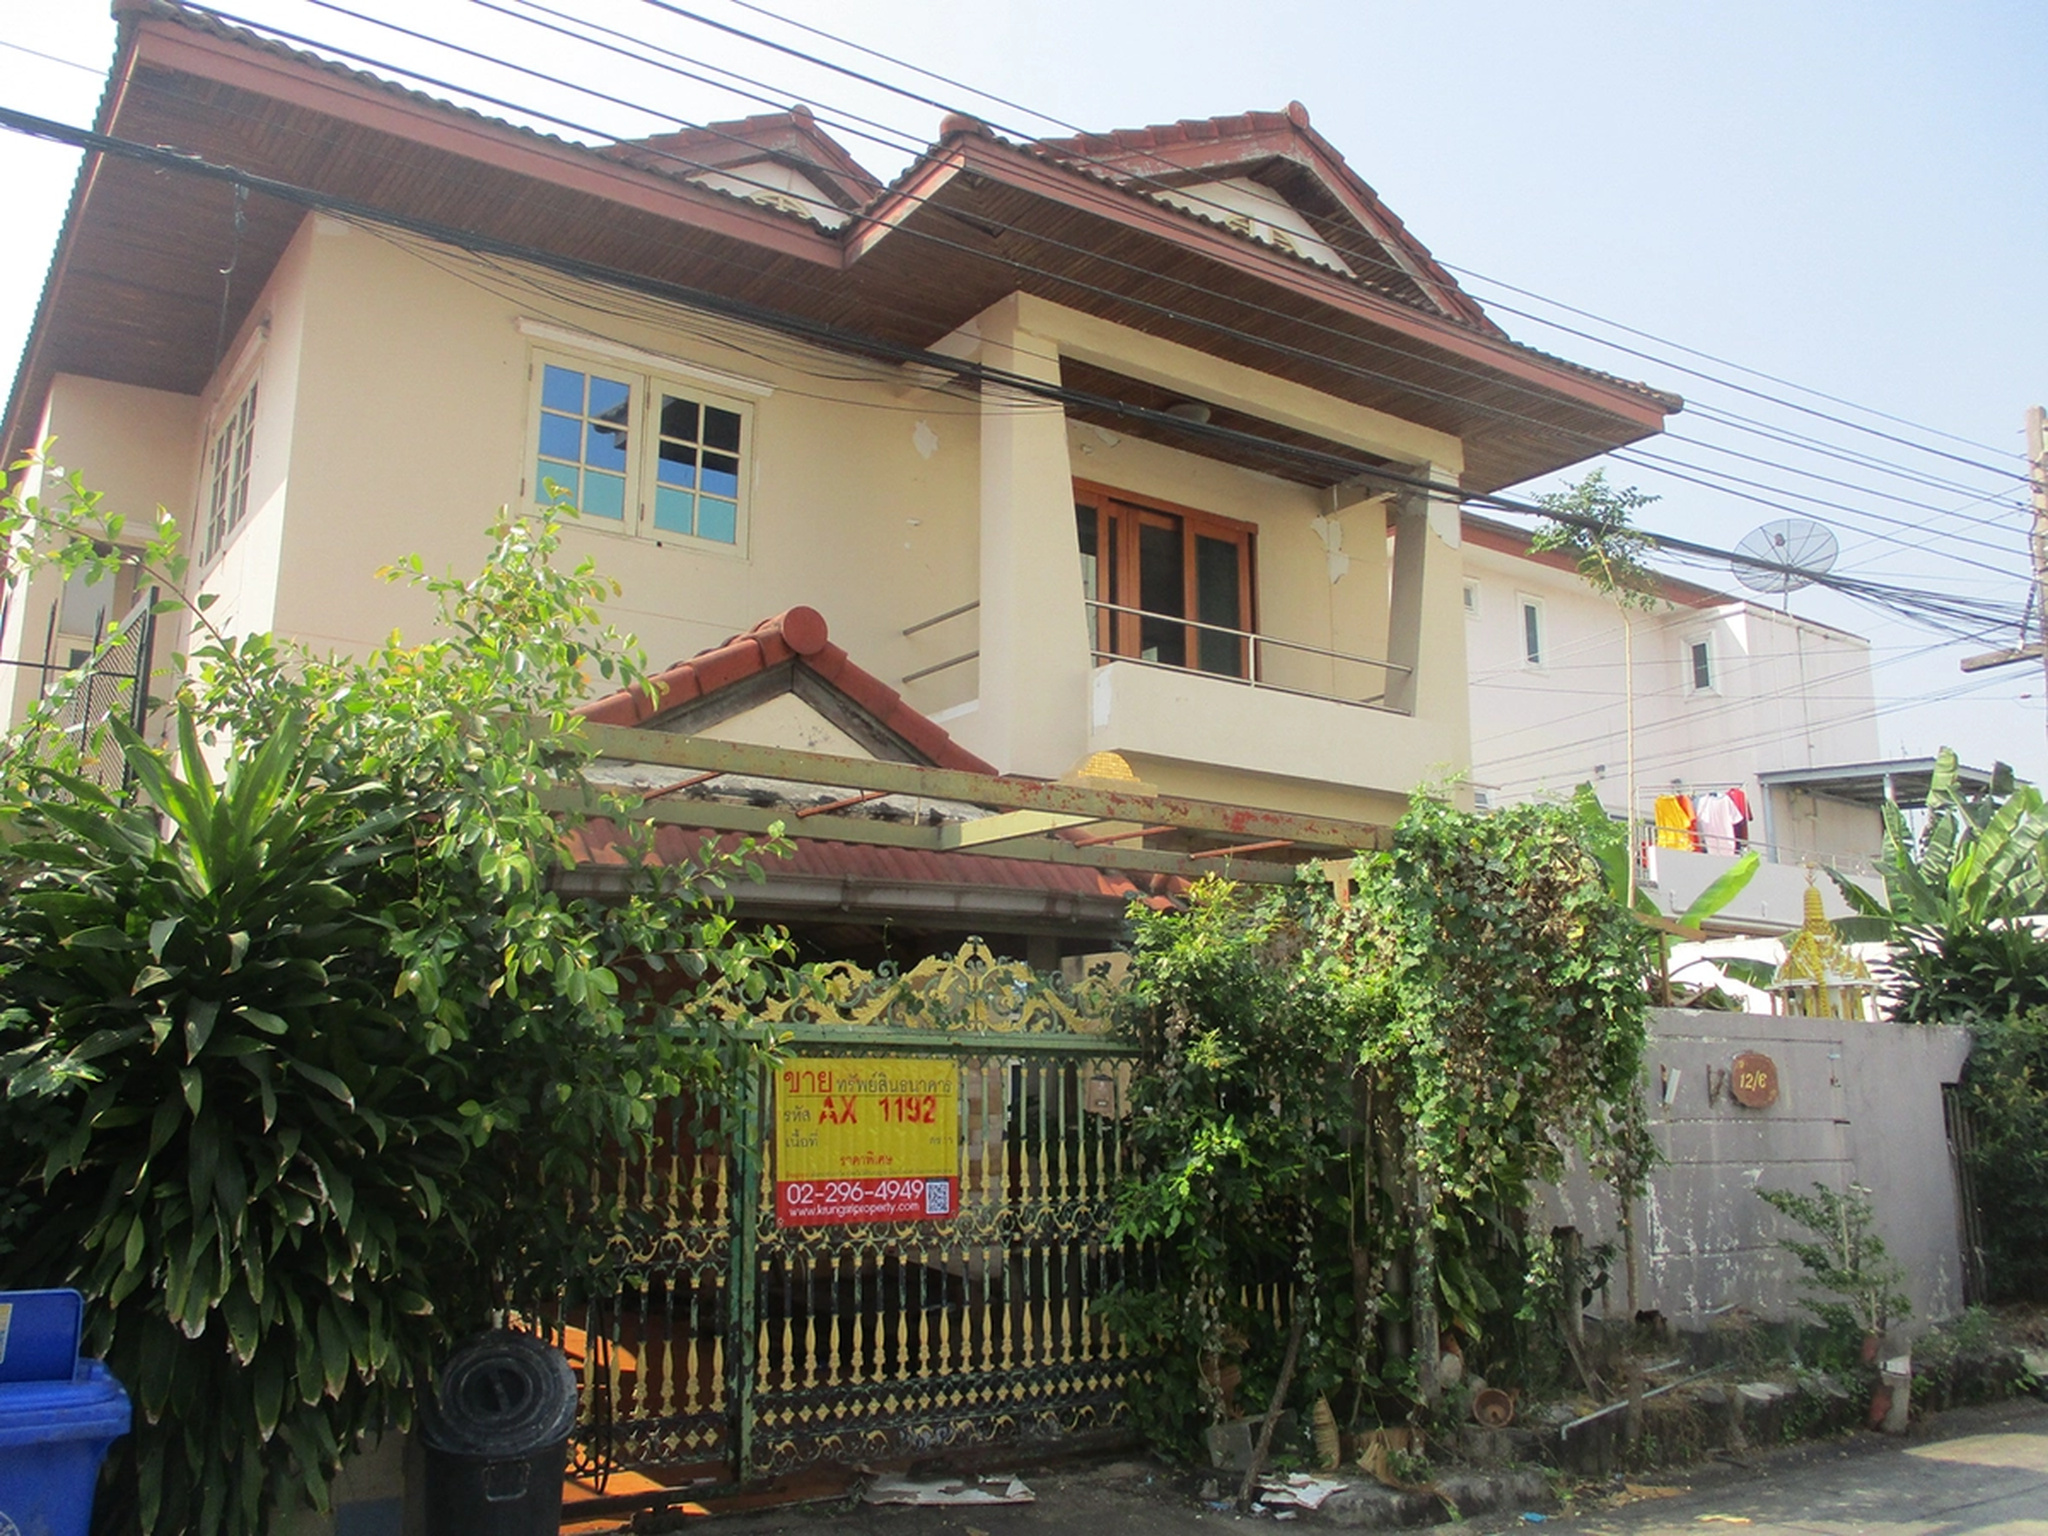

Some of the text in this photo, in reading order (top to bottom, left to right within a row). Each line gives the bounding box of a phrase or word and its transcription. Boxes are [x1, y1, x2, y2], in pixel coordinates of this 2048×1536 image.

[783, 1070, 953, 1093] ขาย ทรัพย์สินธนาคาร
[1740, 1070, 1767, 1092] 12/6
[784, 1095, 937, 1125] รหัส AX 1192
[786, 1179, 924, 1205] 02-296-4949
